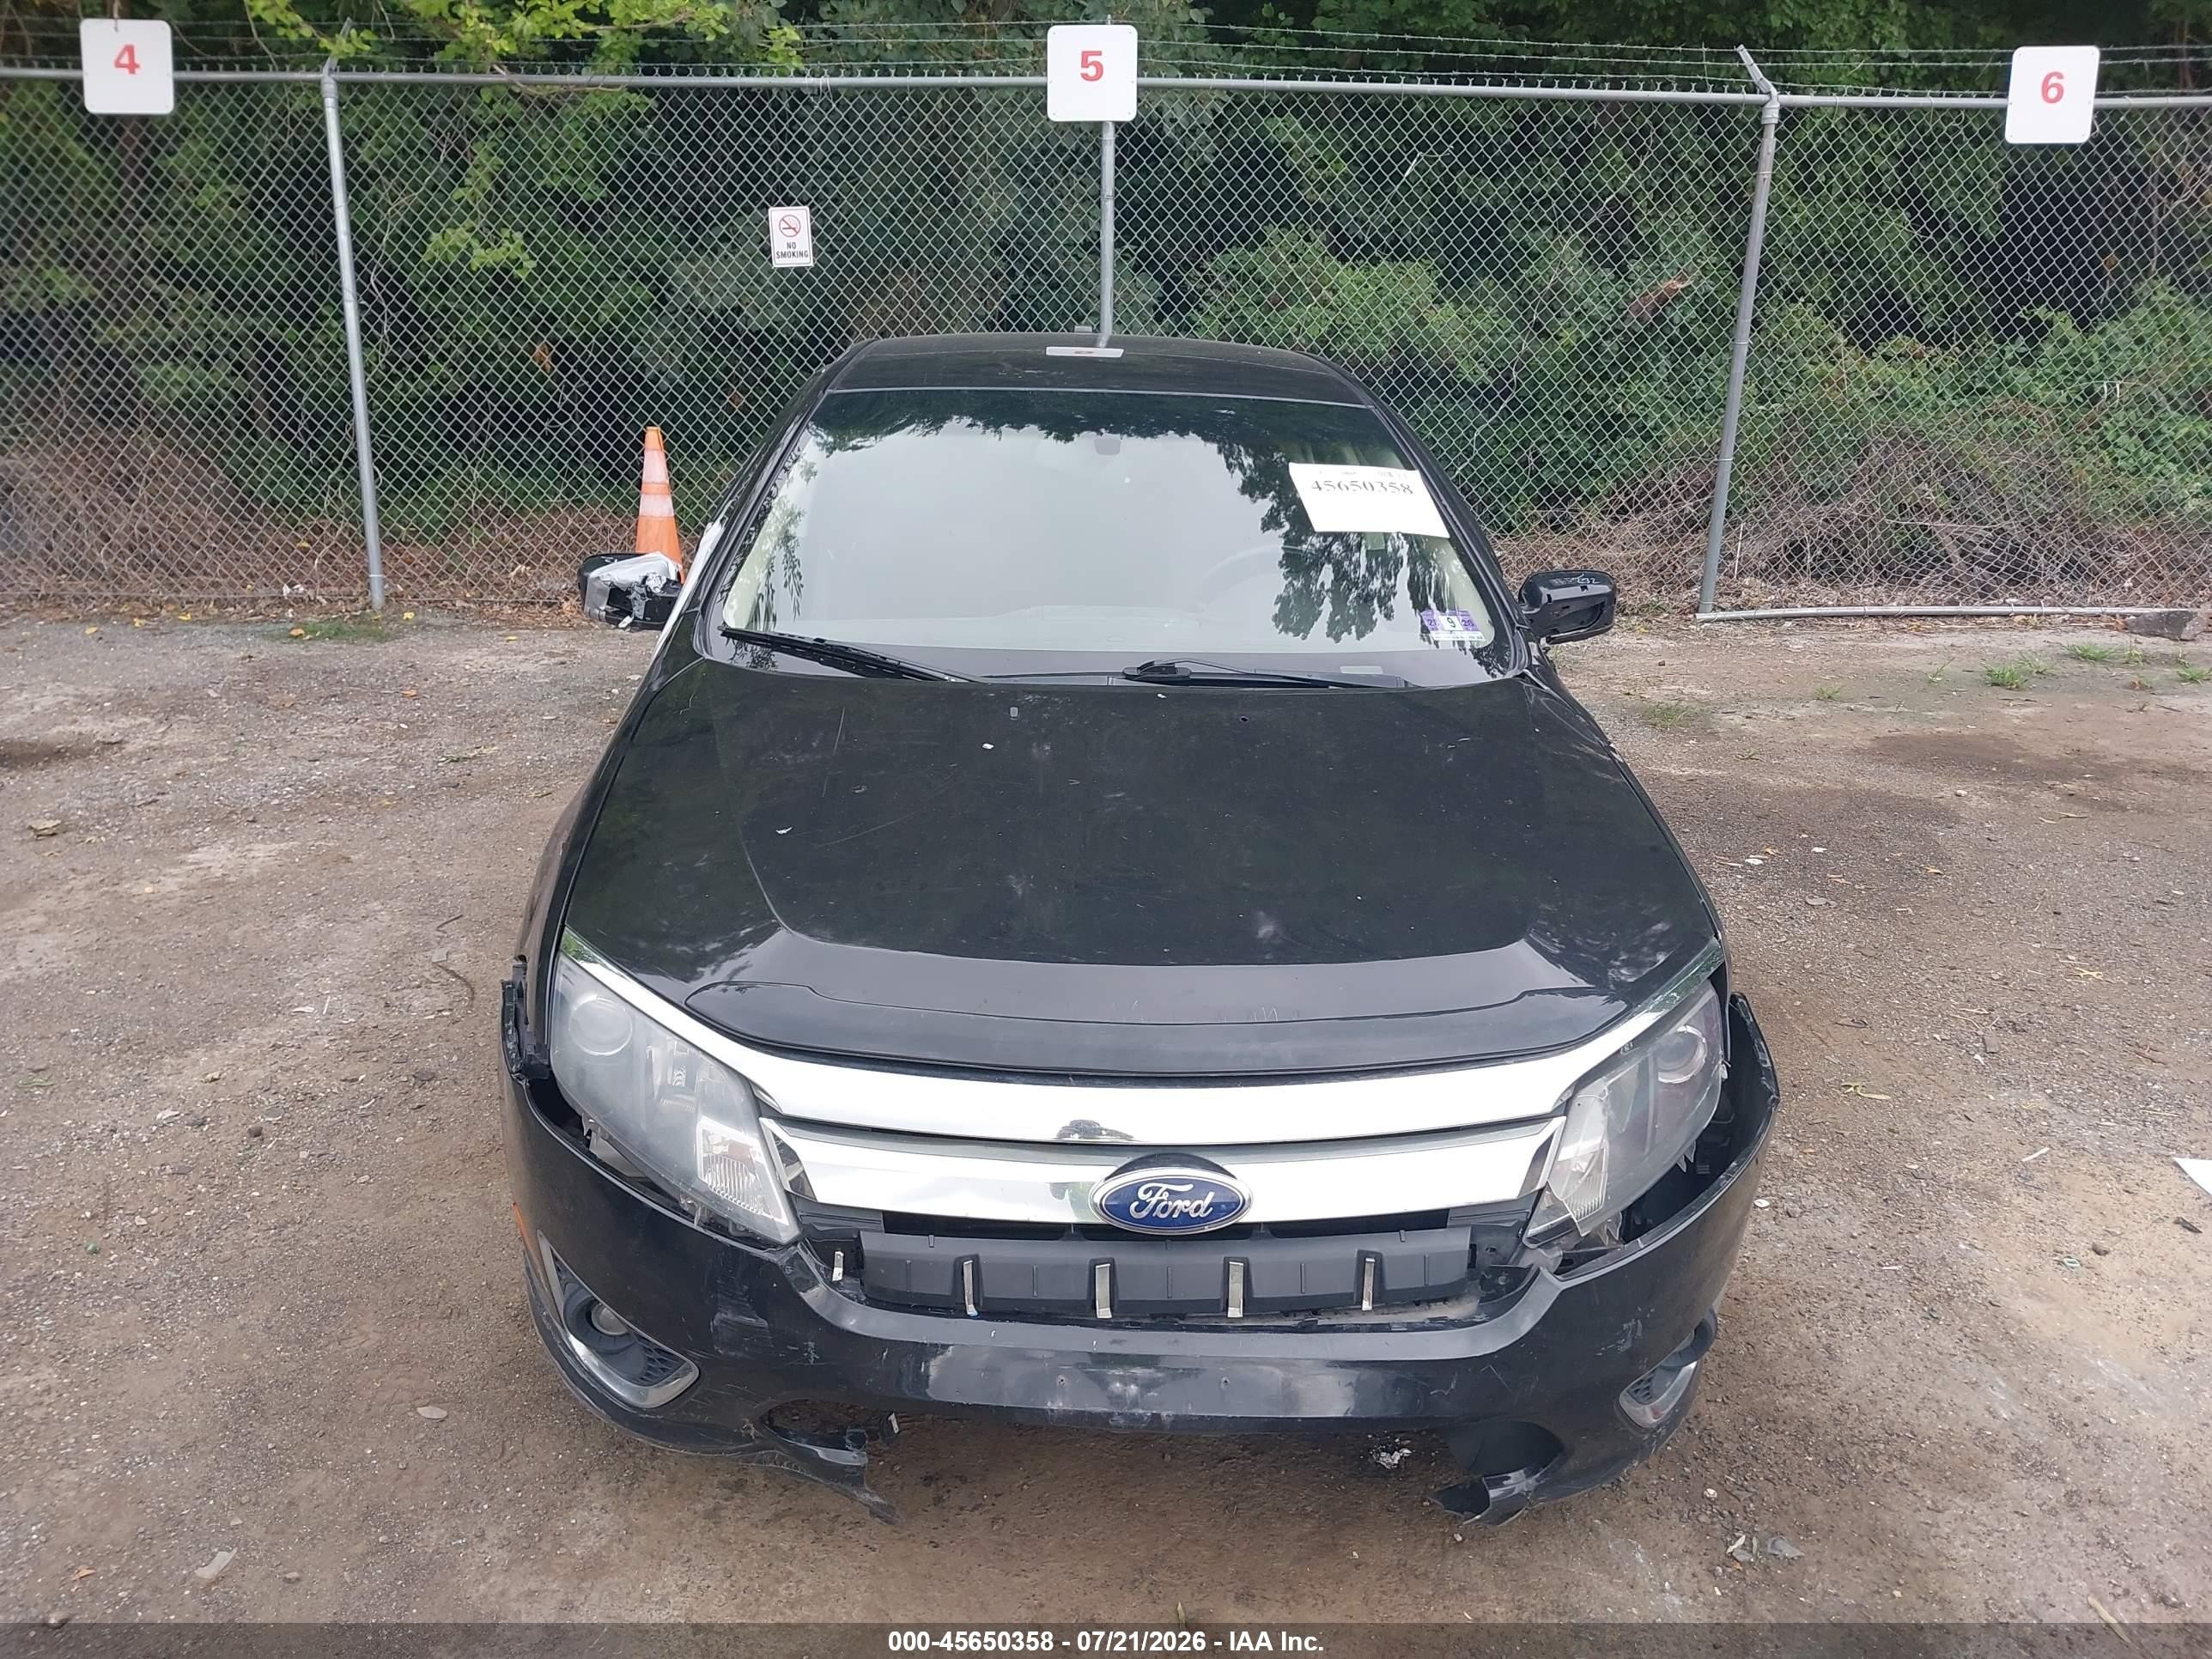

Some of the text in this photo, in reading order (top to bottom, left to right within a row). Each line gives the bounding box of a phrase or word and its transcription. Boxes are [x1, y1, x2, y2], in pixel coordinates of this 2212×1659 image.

[113, 44, 140, 75] 4
[1080, 50, 1103, 82] 5
[2041, 71, 2064, 104] 6
[775, 250, 809, 259] SMOKING
[787, 241, 797, 250] NO
[1311, 480, 1413, 495] 45650358
[1446, 617, 1456, 629] 9
[1129, 1182, 1216, 1219] Ford
